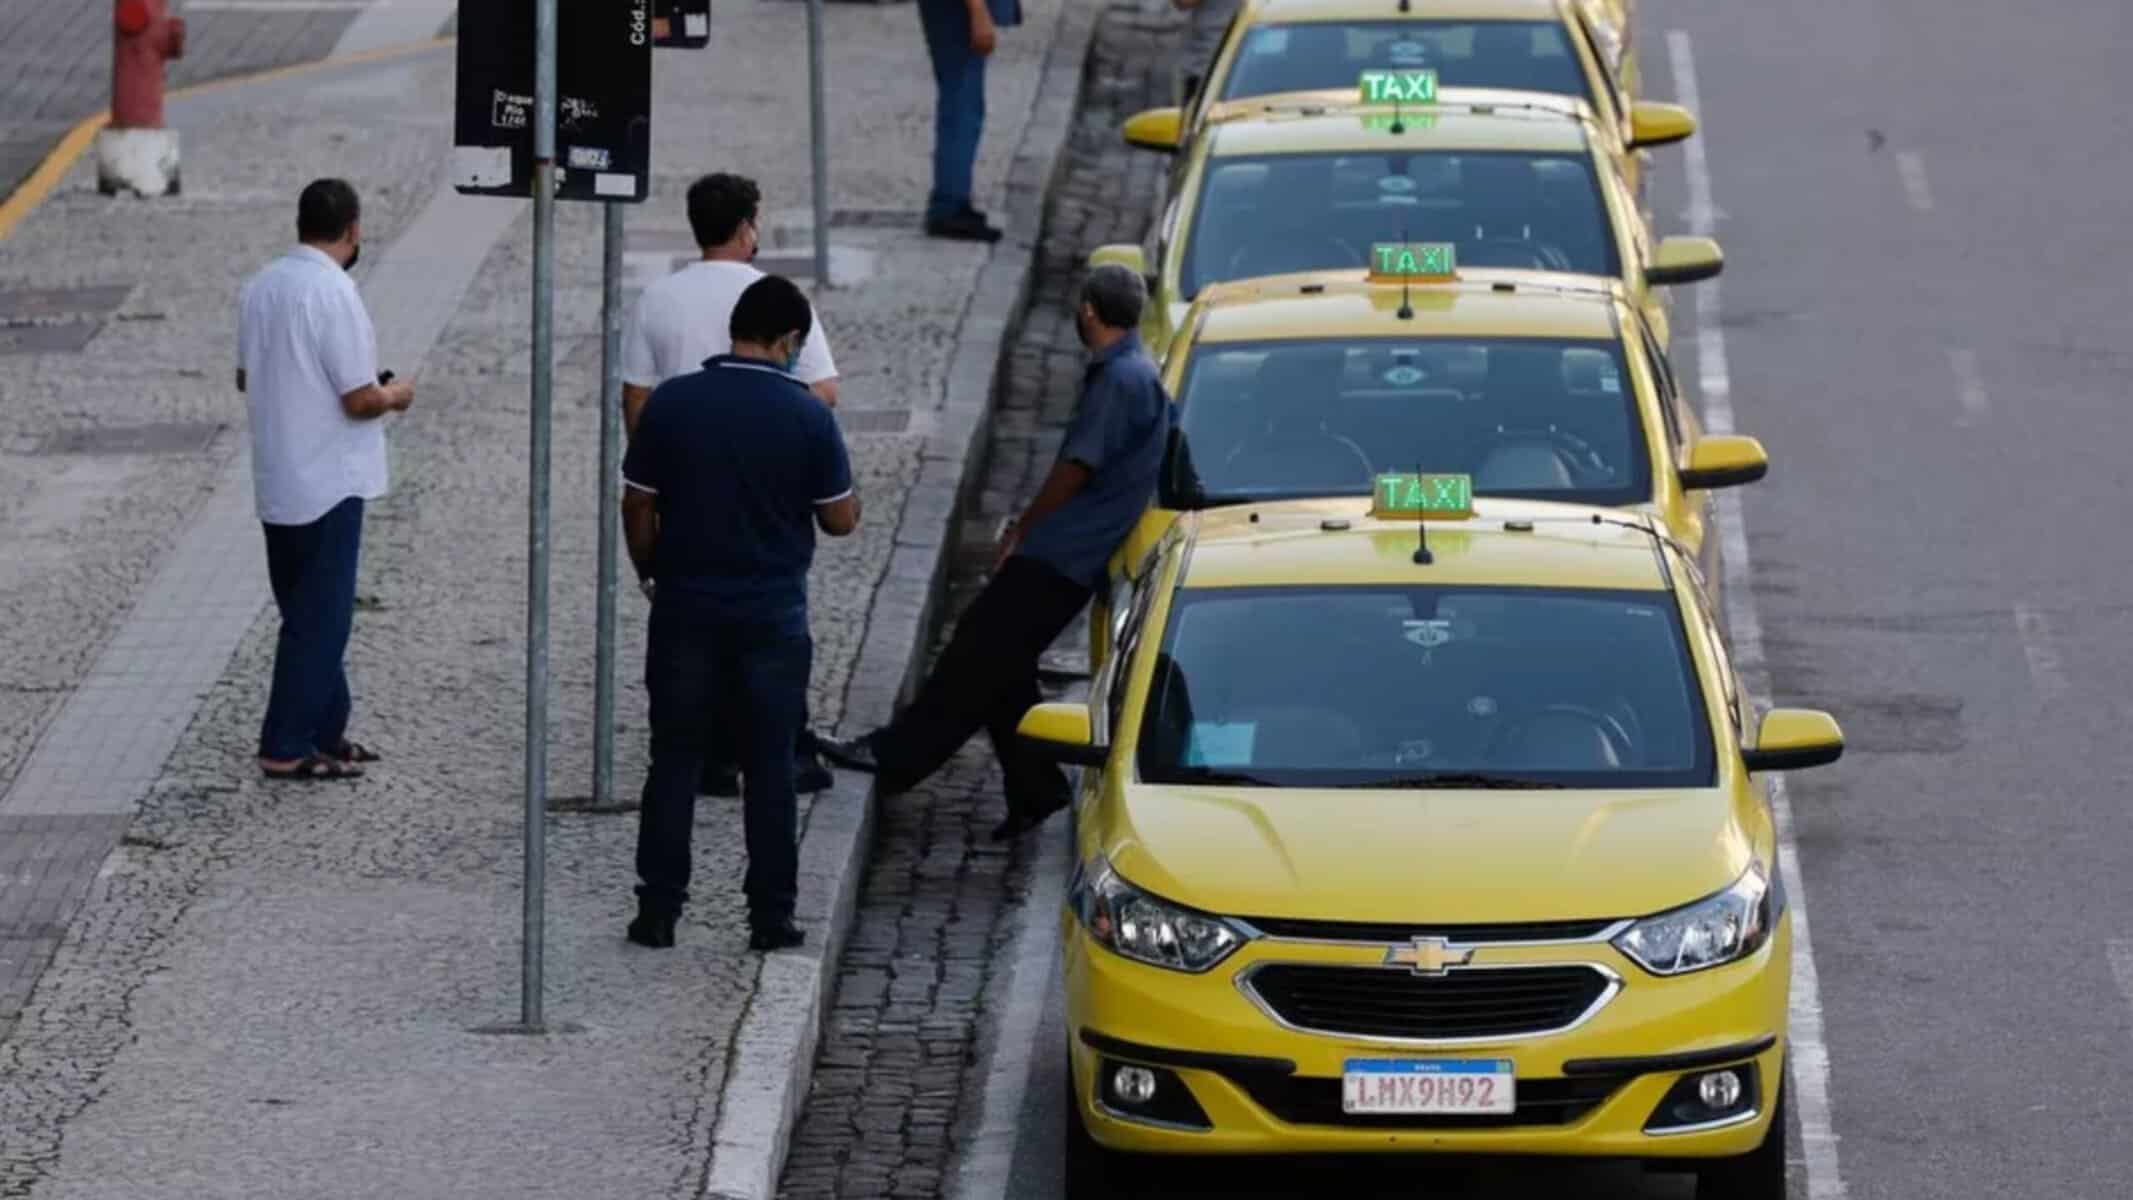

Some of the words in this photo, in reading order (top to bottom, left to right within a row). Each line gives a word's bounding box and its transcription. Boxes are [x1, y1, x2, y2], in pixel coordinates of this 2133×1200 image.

[1362, 73, 1434, 101] TAXI
[1376, 247, 1450, 274] TAXI
[1381, 478, 1465, 509] TAXI
